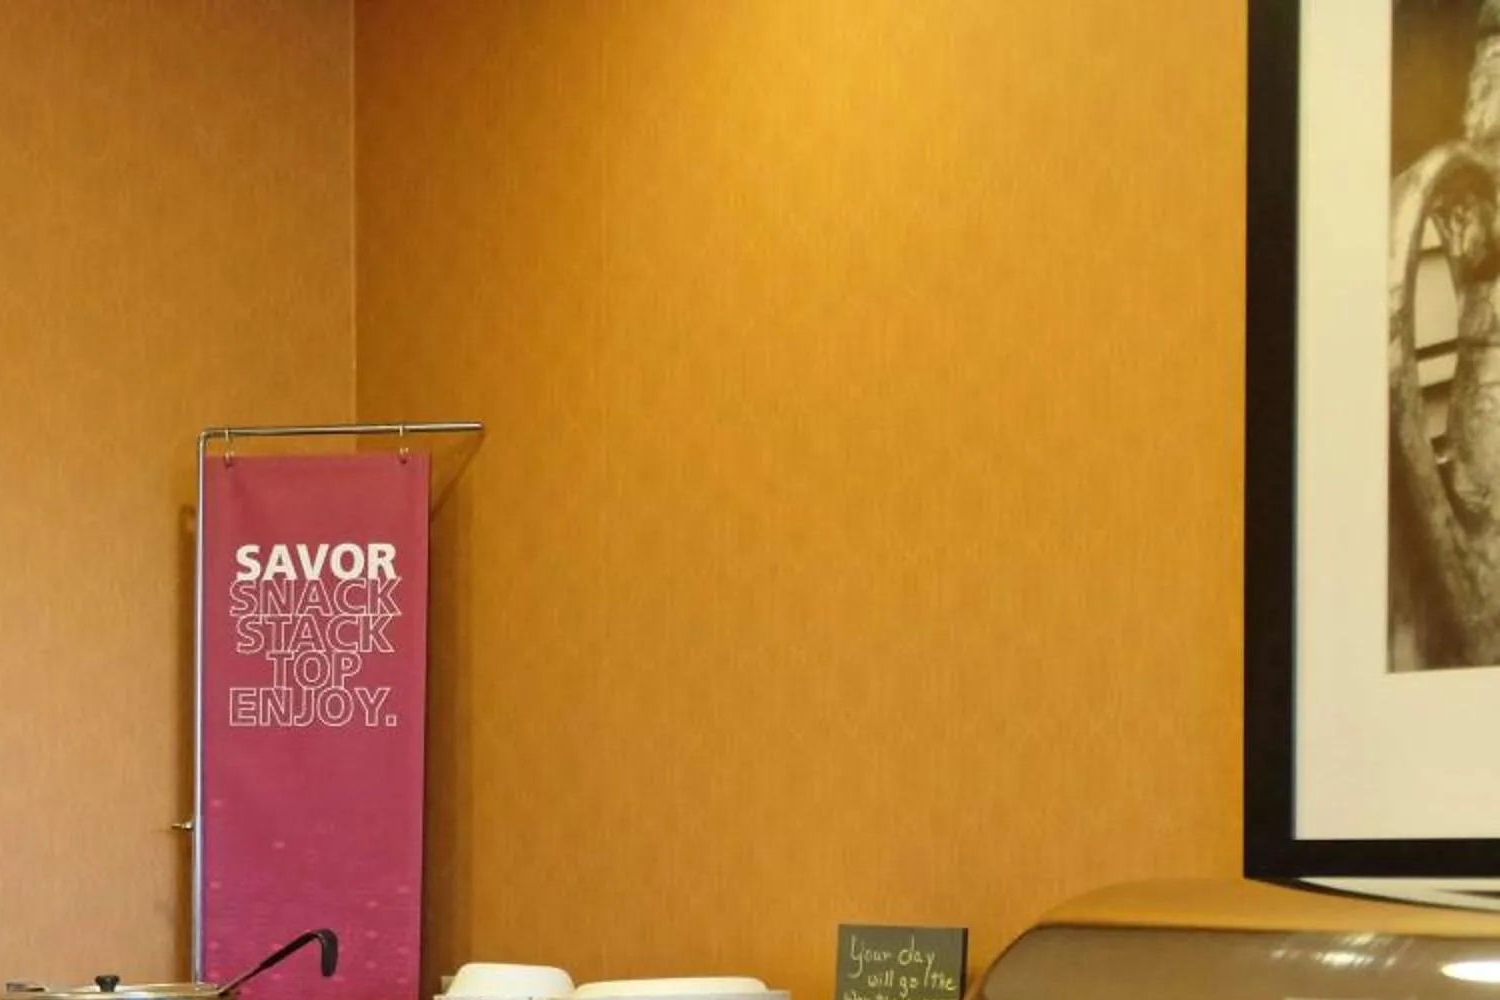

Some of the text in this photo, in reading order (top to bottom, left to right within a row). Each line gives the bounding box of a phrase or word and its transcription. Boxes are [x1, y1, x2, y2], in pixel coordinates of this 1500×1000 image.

[235, 543, 398, 580] SAVOR
[229, 577, 402, 616] SNACK
[235, 613, 395, 654] STACK
[266, 651, 362, 689] TOP
[229, 687, 398, 727] ENJOY.
[847, 934, 935, 988] Your day
[867, 969, 957, 999] will go the
